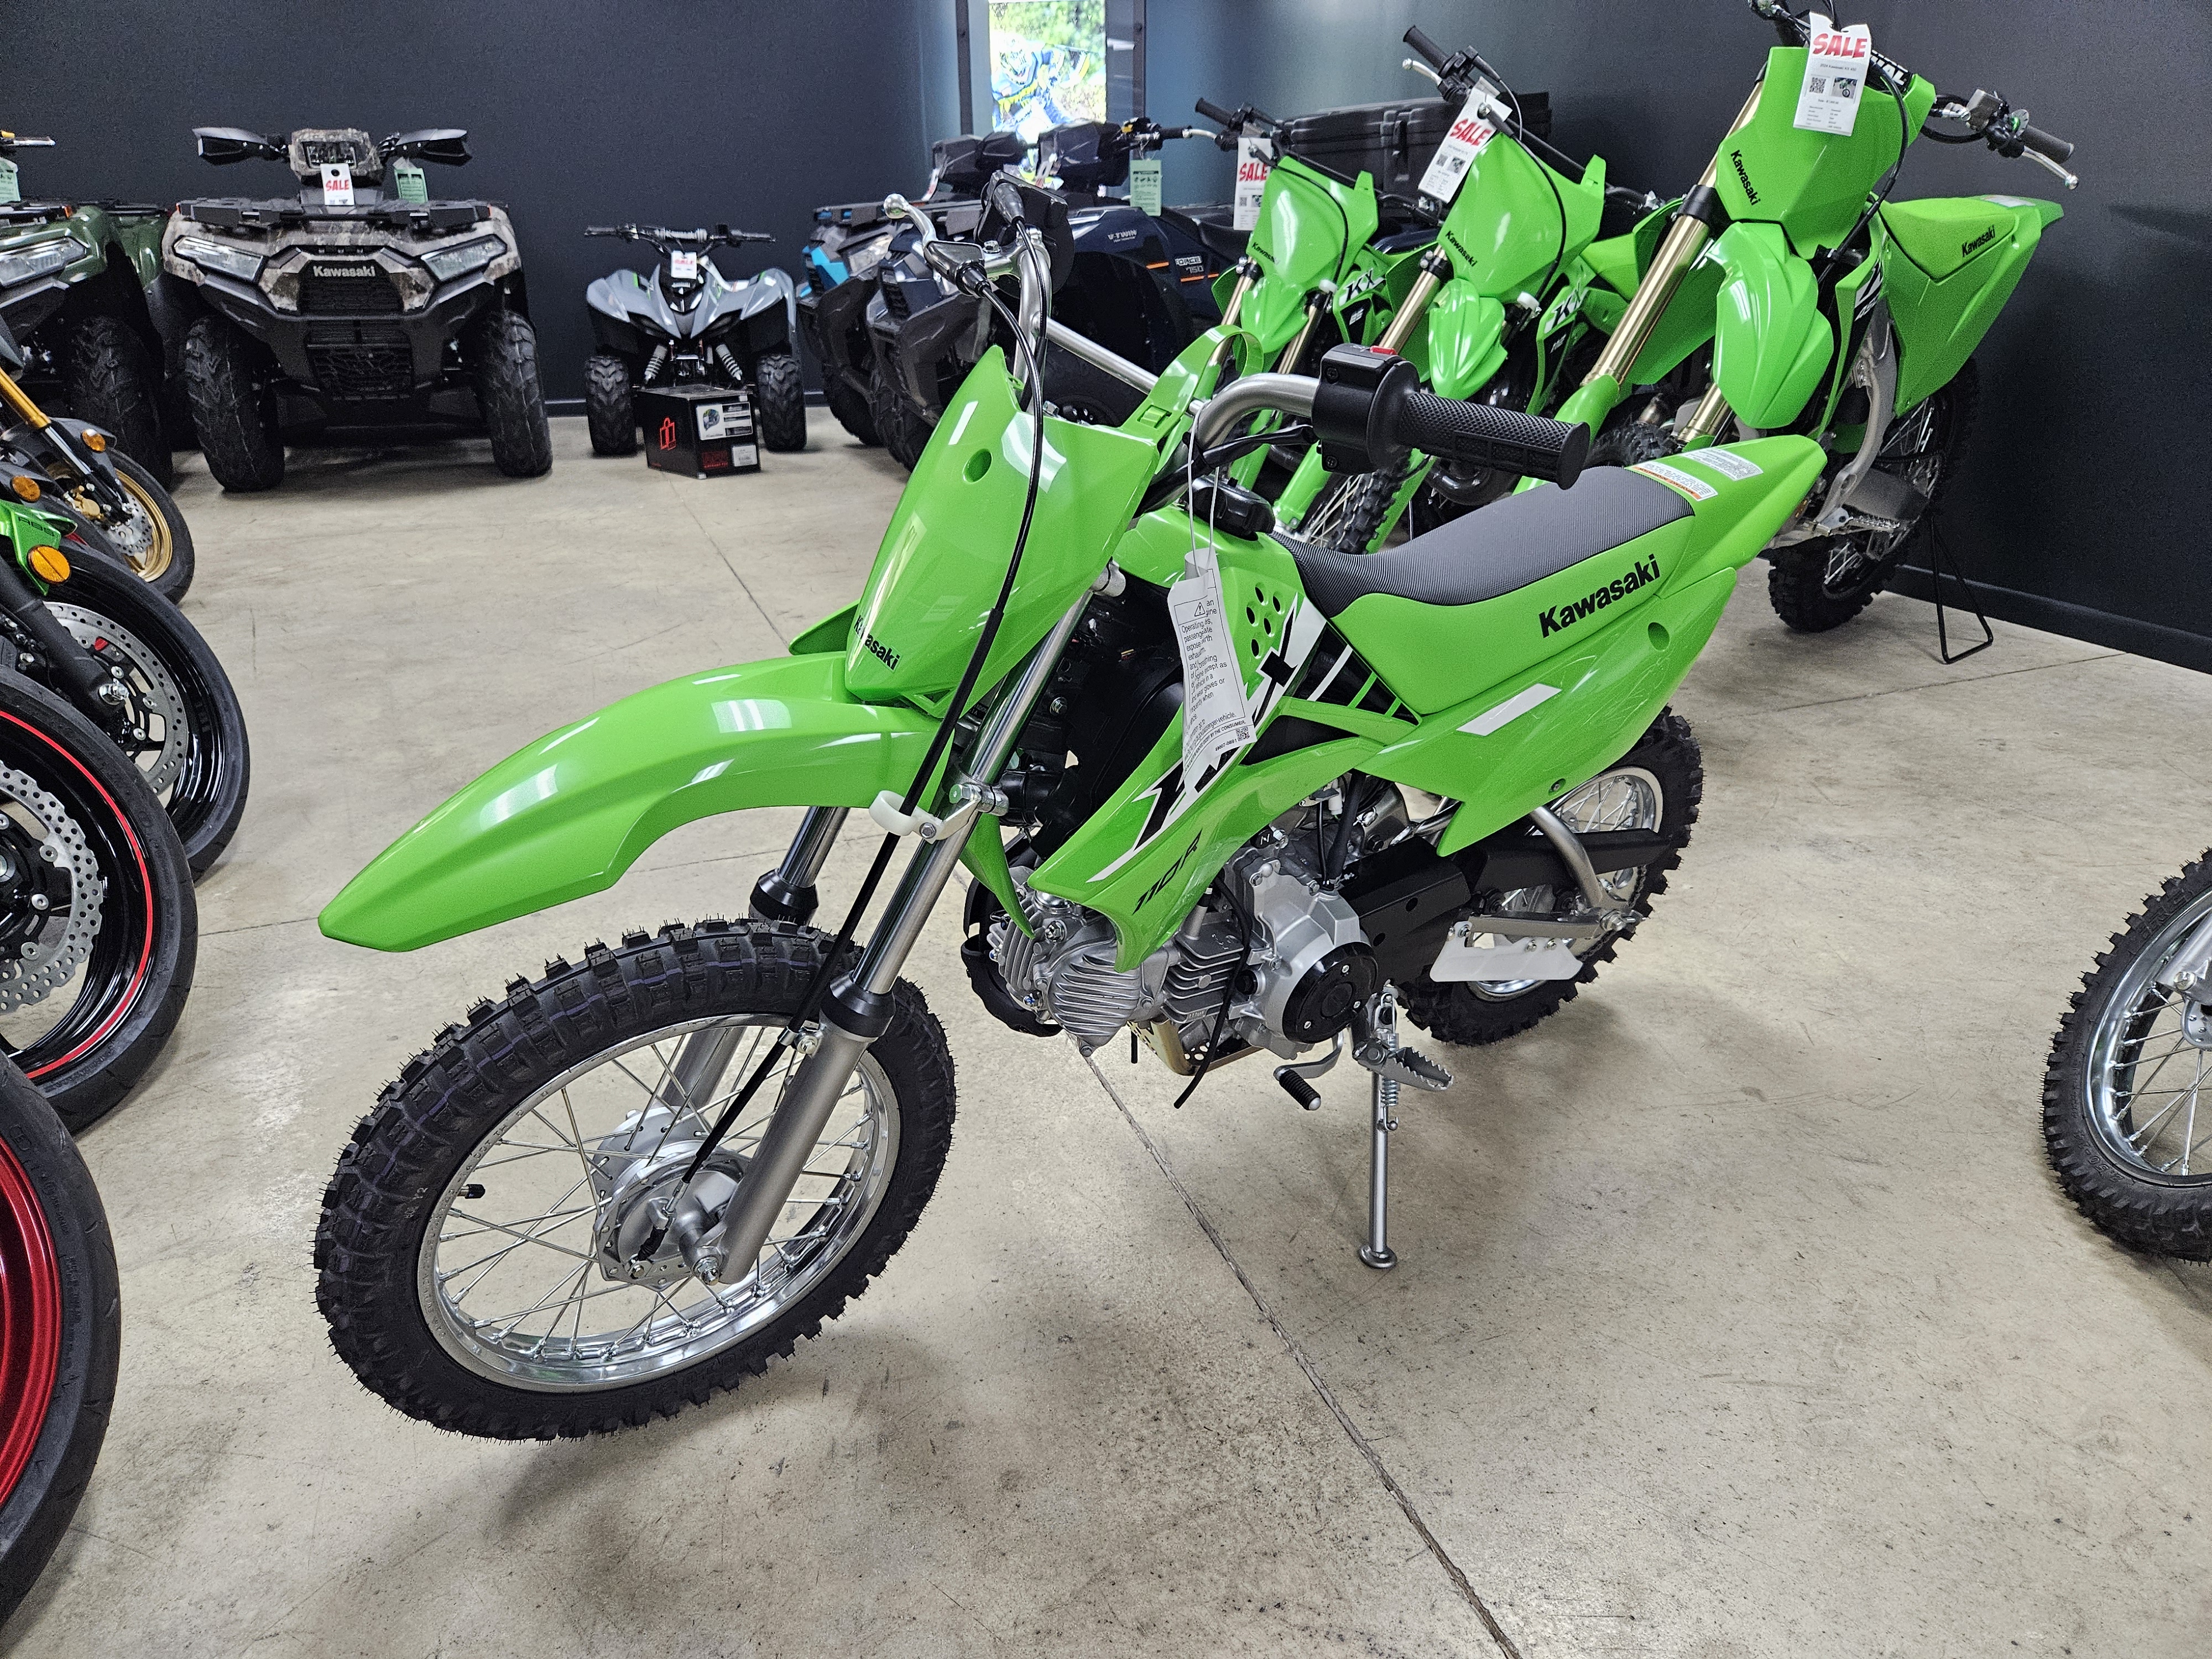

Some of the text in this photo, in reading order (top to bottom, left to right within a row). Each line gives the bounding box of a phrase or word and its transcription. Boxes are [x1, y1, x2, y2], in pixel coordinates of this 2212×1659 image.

[1812, 33, 1867, 59] SALE
[1449, 118, 1493, 147] SALE
[1239, 162, 1269, 182] SALE
[1730, 149, 1761, 206] Kawasaki
[325, 179, 349, 191] SALE
[1108, 229, 1138, 240] V-TWIN
[1961, 224, 1996, 258] Kawasaki
[1445, 230, 1478, 267] Kawasaki
[312, 265, 376, 277] Kawasaki
[1186, 265, 1204, 274] 750
[18, 517, 55, 536] ABS
[1538, 554, 1661, 638] Kawasaki
[1181, 621, 1204, 633] Operating
[1186, 641, 1202, 652] expose
[1203, 680, 1218, 693] gloves
[1202, 692, 1214, 702] when
[1221, 719, 1246, 732] CONSUMER.
[1215, 738, 1237, 752] 49007-0891
[1132, 828, 1203, 916] 110R
